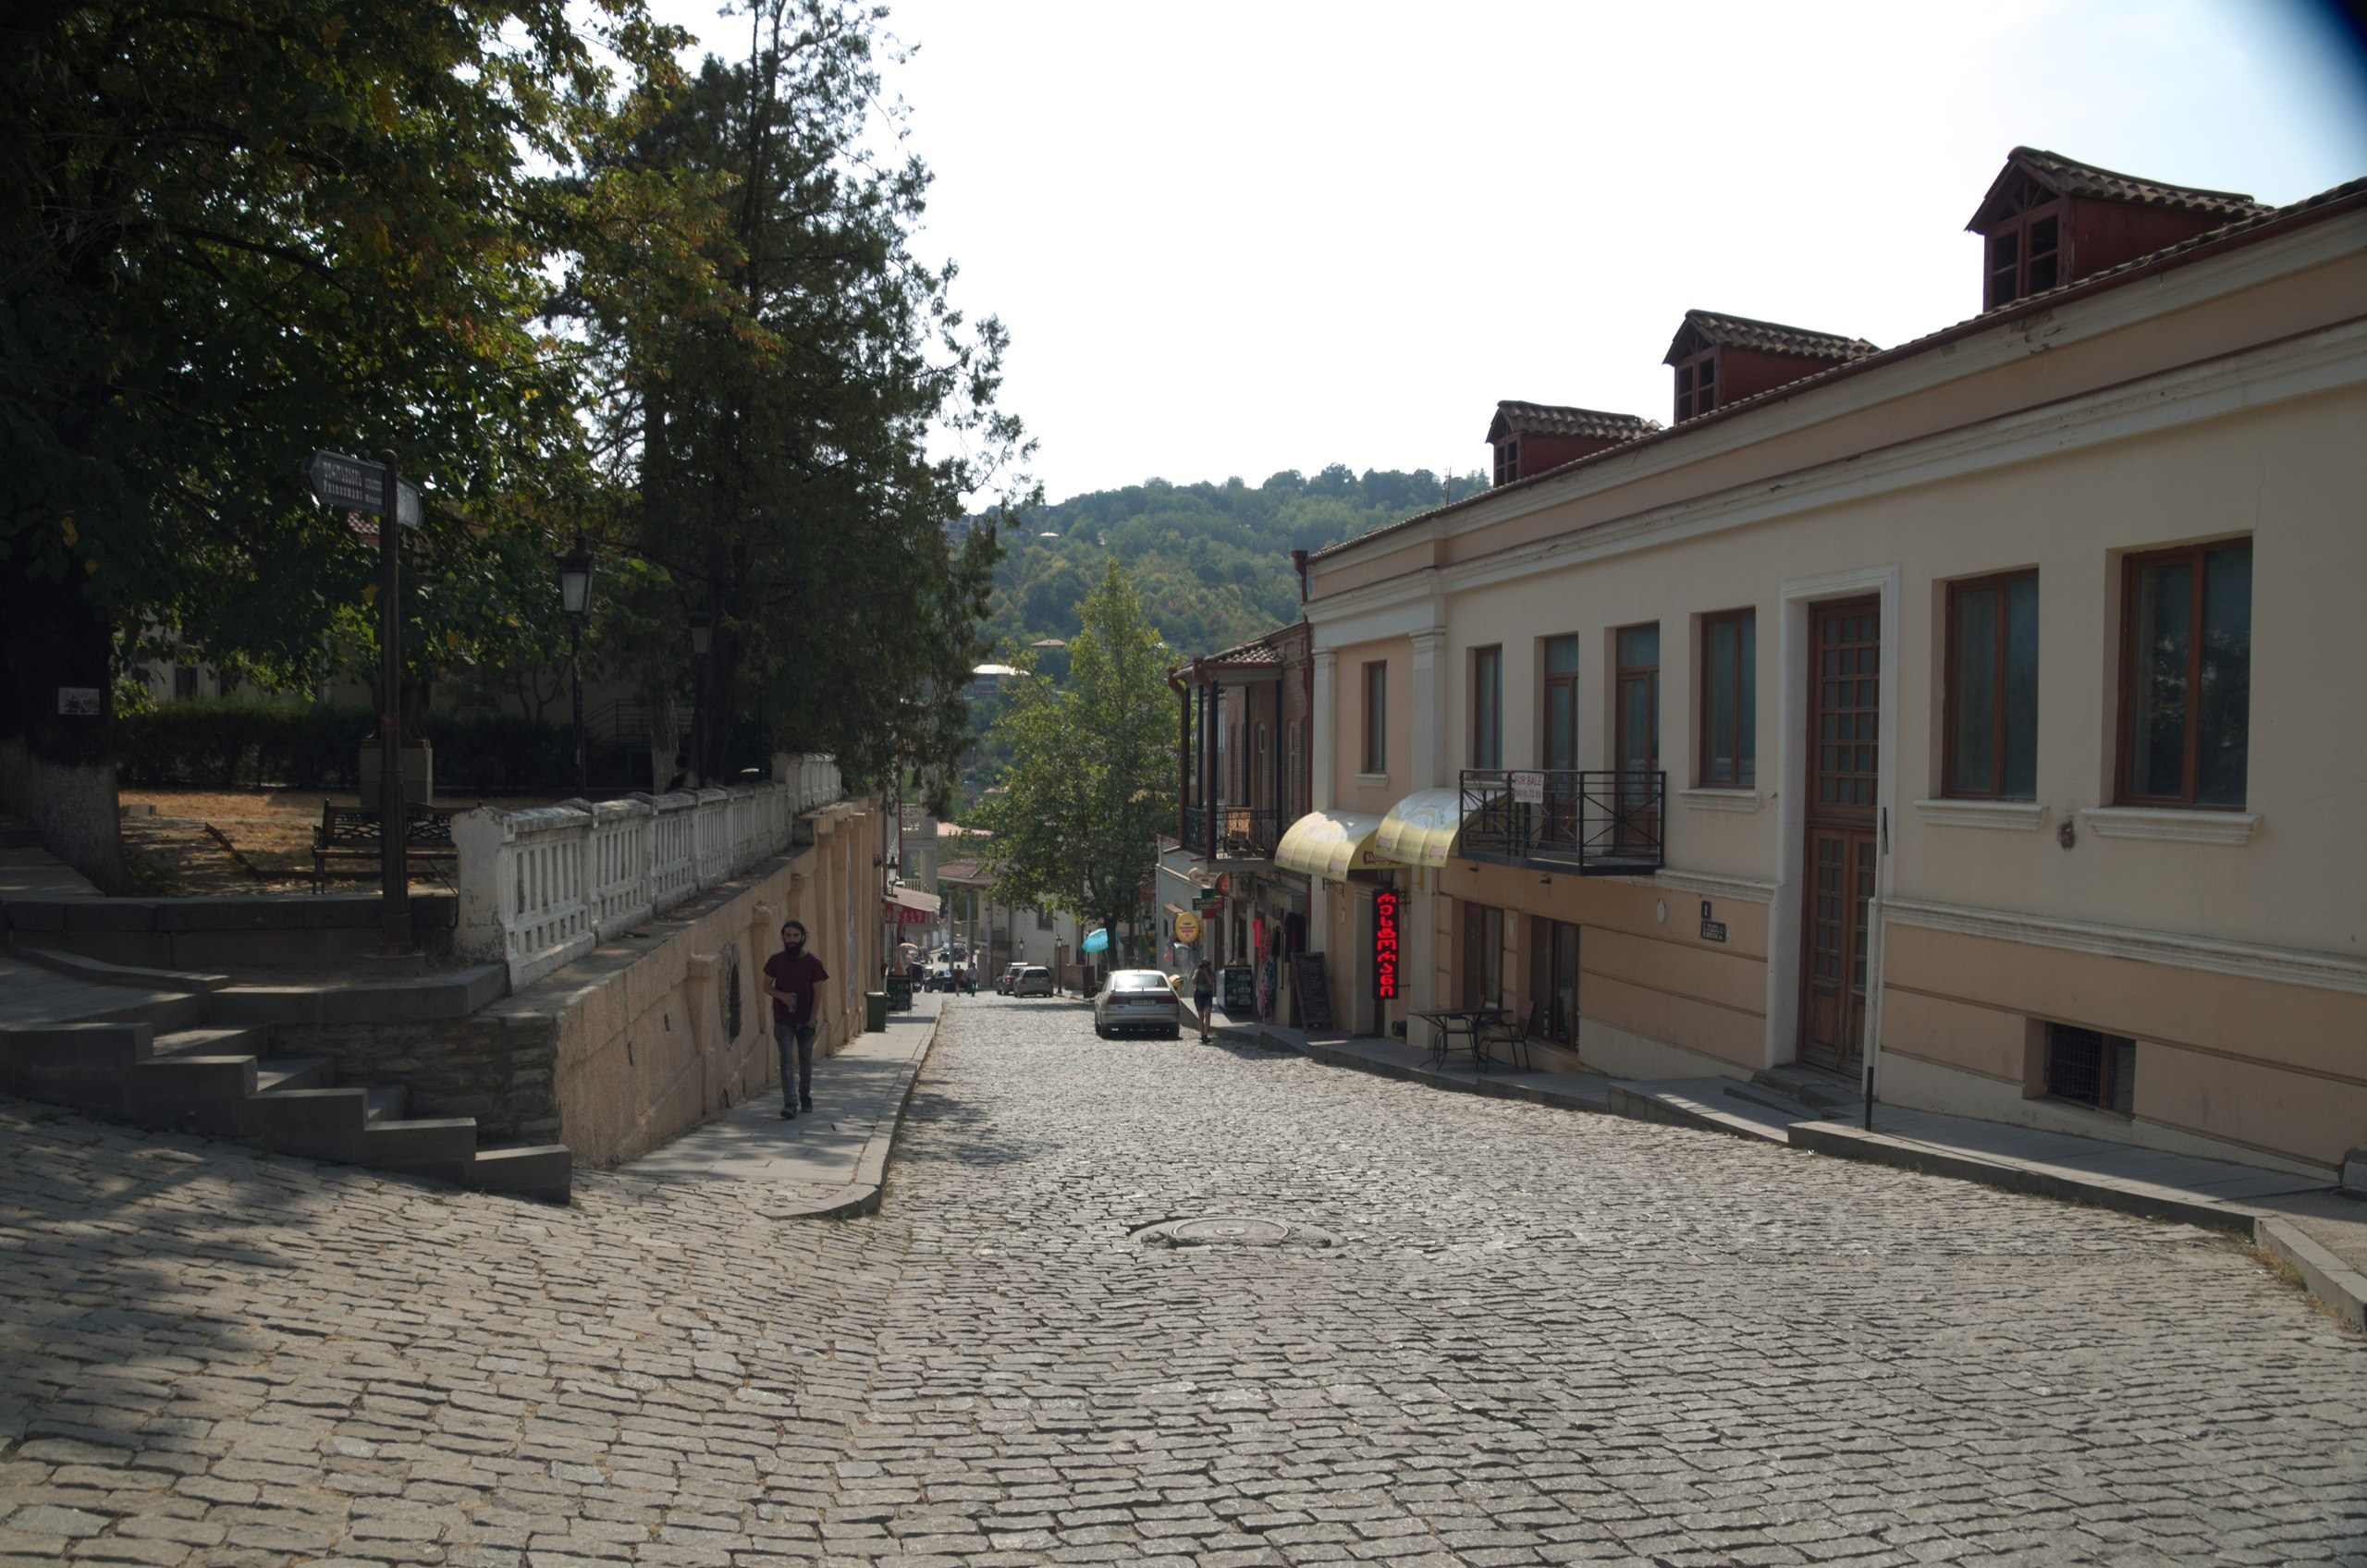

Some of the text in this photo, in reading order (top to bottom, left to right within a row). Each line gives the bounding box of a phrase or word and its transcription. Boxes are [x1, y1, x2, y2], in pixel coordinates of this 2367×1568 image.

[1515, 776, 1541, 786] FOR SALE
[1377, 892, 1397, 998] რესტორანი
